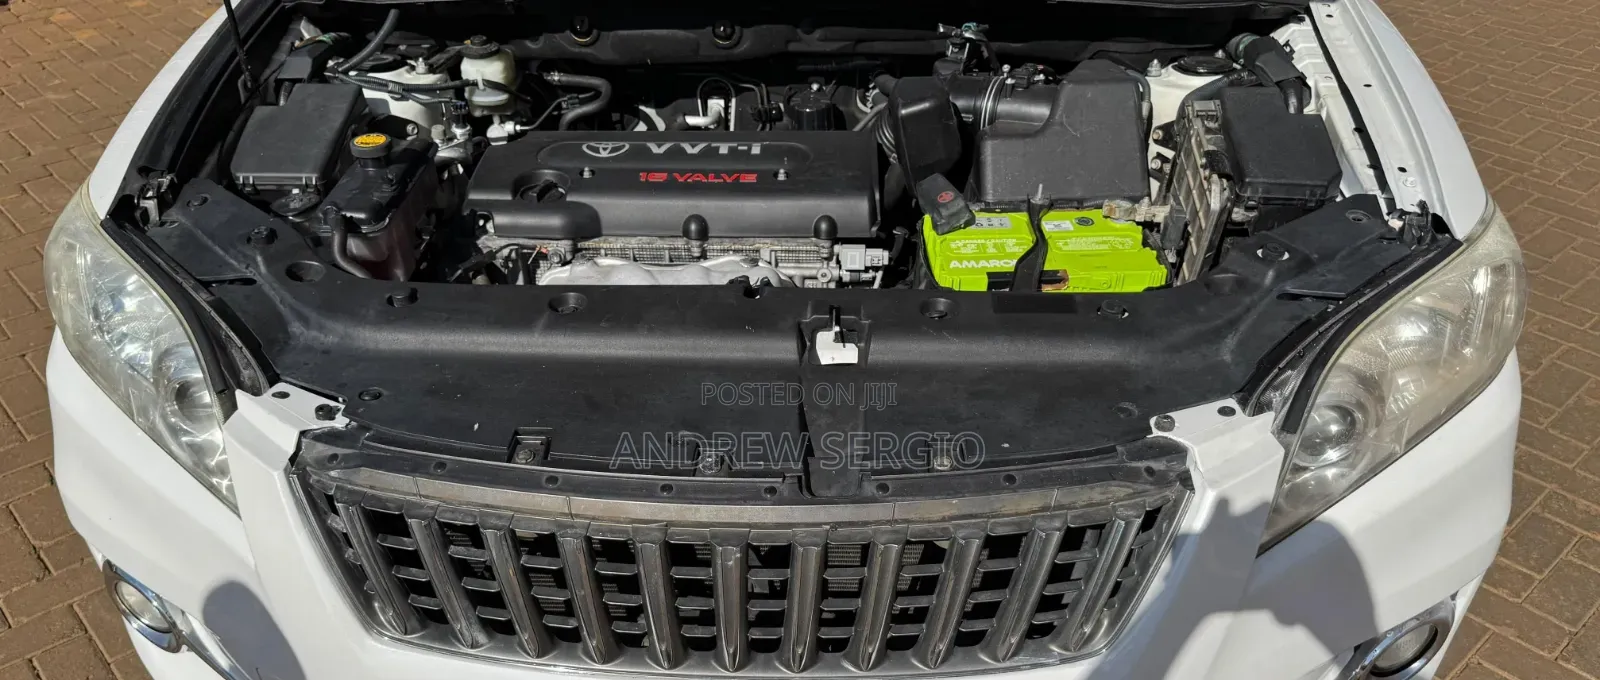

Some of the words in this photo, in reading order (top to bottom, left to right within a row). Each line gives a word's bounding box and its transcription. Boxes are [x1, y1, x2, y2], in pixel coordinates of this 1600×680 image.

[646, 142, 761, 154] VVT-i
[639, 172, 668, 182] 16
[672, 172, 758, 182] VALVE
